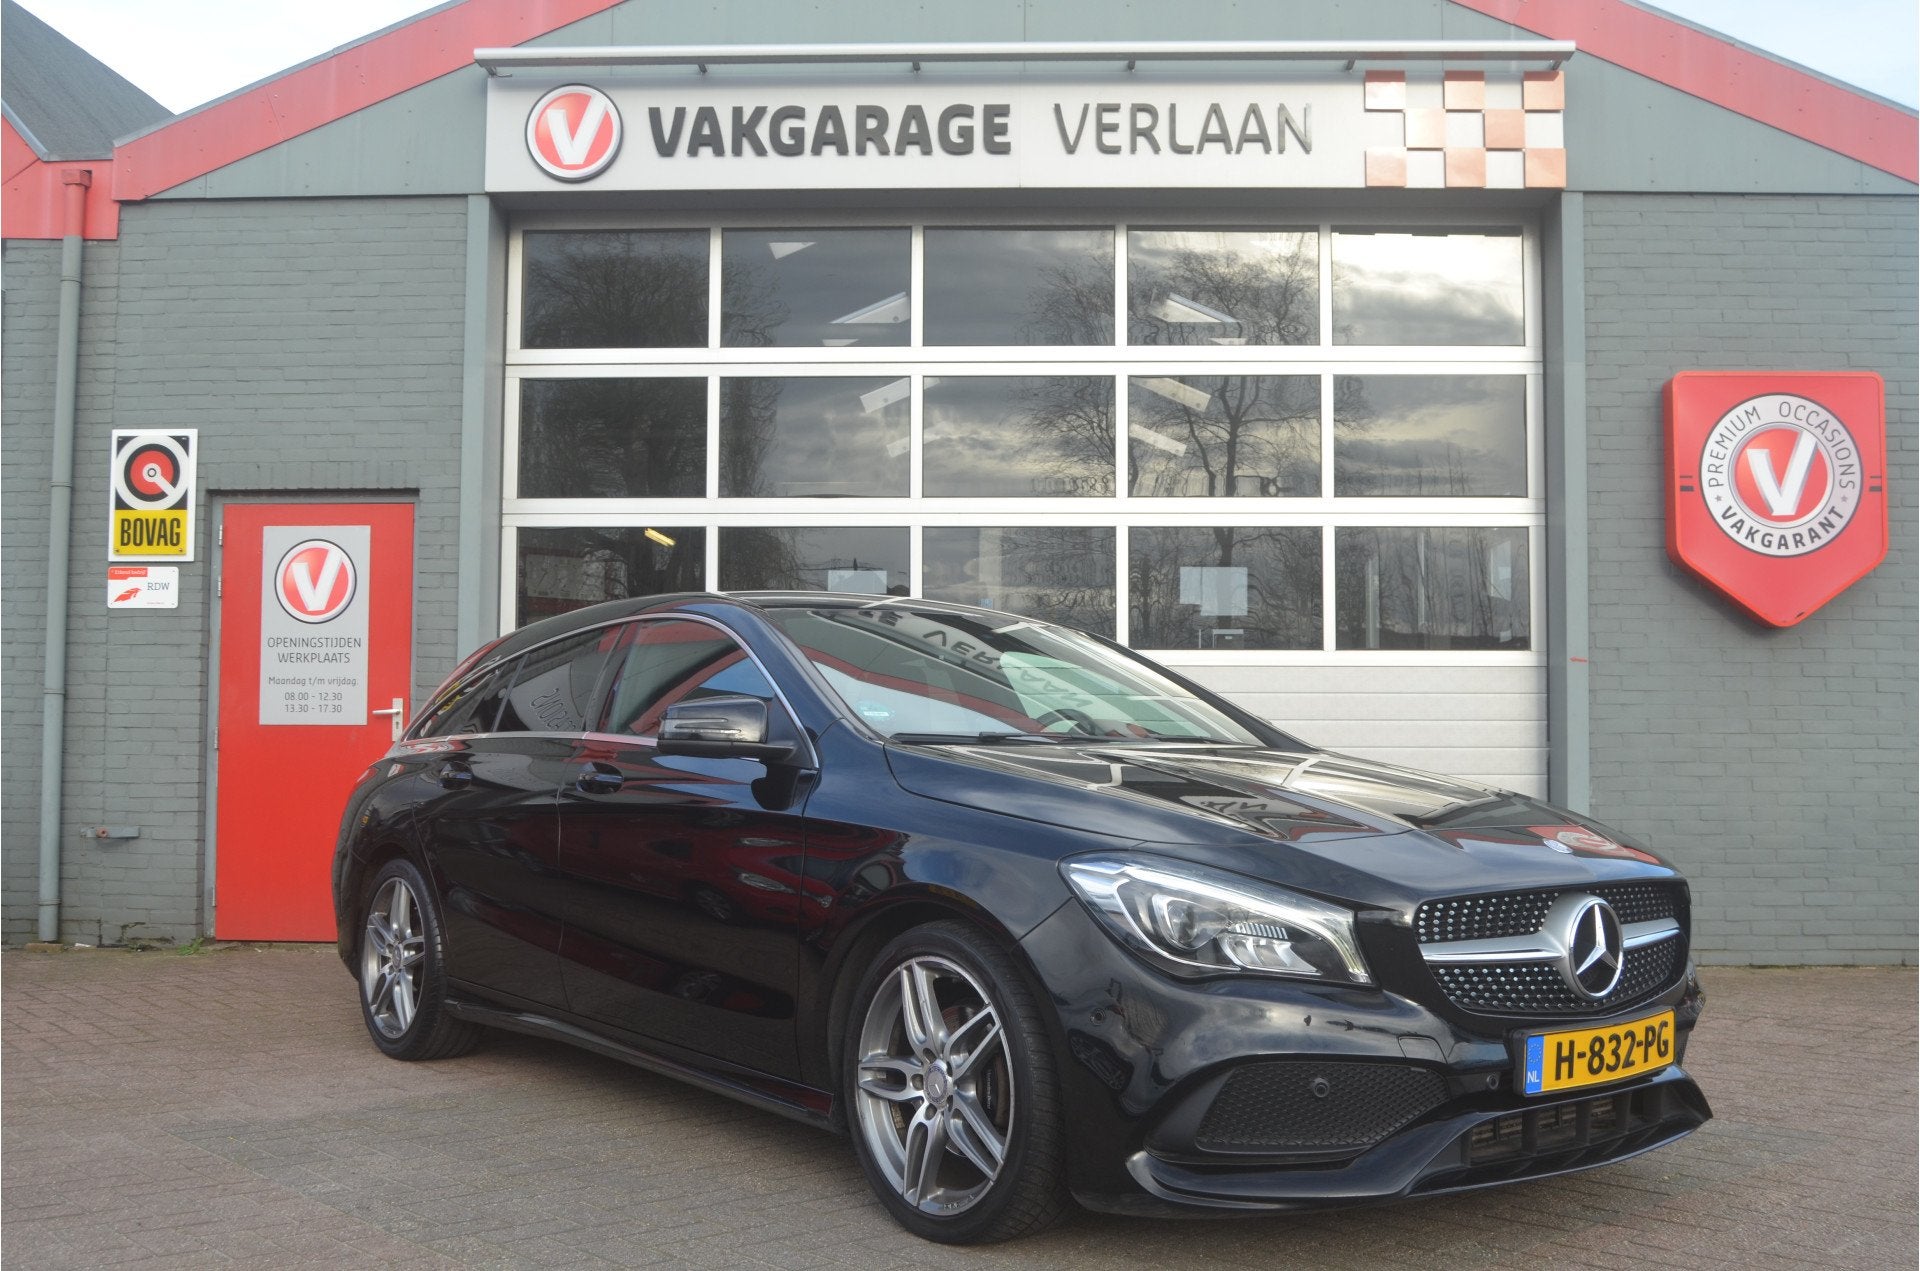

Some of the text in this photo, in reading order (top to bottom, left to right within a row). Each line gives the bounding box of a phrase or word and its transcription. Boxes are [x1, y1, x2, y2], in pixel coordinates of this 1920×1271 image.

[546, 94, 607, 165] V
[648, 103, 1313, 157] VAKGARAGE VERLAAN
[1708, 401, 1856, 490] PREMIUM OCCASIONS
[1746, 429, 1819, 516] V
[120, 517, 181, 547] BOVAG
[1720, 505, 1845, 550] VAKGARANT
[147, 582, 170, 591] RDW
[290, 548, 343, 611] V
[267, 637, 362, 648] OPENINGSTIJDEN
[277, 652, 351, 664] WERKPLAATS
[268, 677, 306, 687] Maandag
[308, 676, 326, 687] t/m
[284, 692, 309, 701] 08.00
[318, 692, 343, 701] 12.30
[284, 704, 309, 713] 13.30
[318, 704, 343, 713] 17.30
[1554, 1020, 1669, 1081] H-832-PG
[1527, 1071, 1540, 1083] NL
